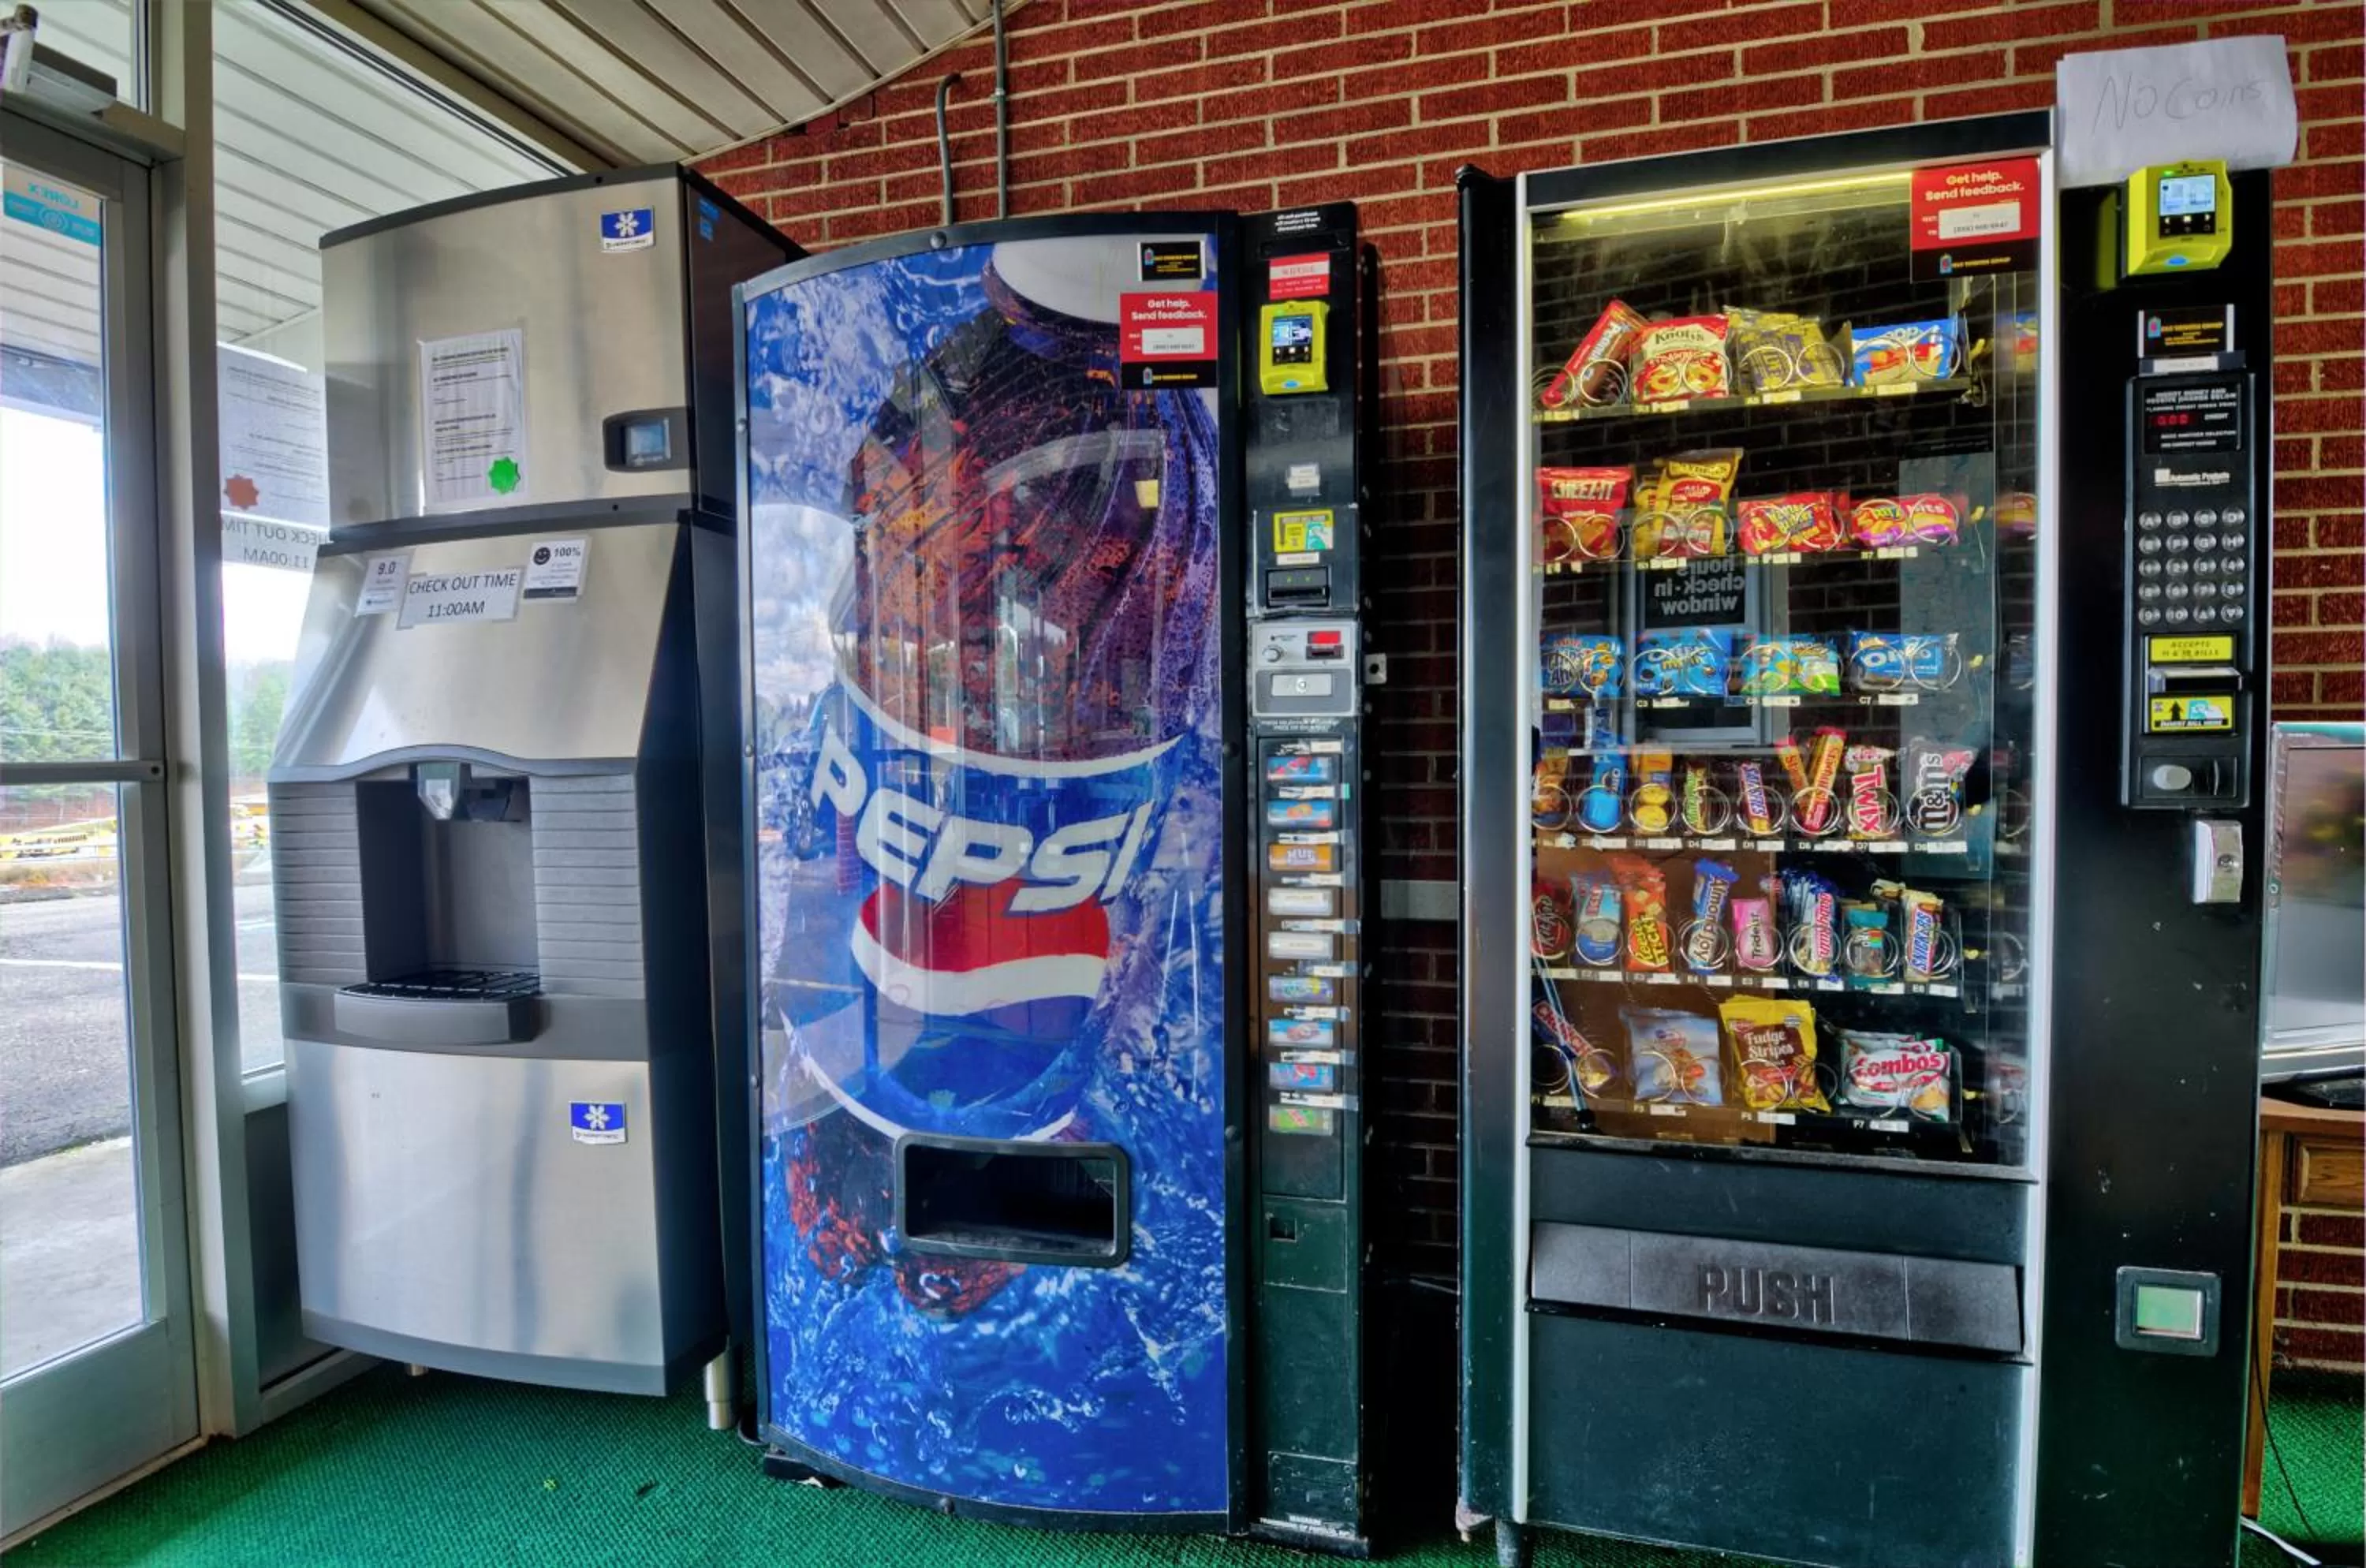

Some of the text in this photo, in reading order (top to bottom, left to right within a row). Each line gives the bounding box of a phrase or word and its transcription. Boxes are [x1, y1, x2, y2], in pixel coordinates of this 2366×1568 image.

[2092, 73, 2262, 133] No Coins
[1946, 170, 2003, 185] Get help.
[1925, 181, 2025, 201] Send feedback.
[1148, 297, 1190, 309] Get help.
[1131, 309, 1207, 321] Send feedback.
[553, 546, 580, 557] 100%
[409, 577, 447, 595] CHECK
[452, 575, 480, 592] OUT
[483, 573, 517, 588] TIME
[427, 600, 486, 618] 11:00AM
[1853, 764, 1883, 832] TWIX
[810, 720, 1155, 913] PEPSI
[1695, 873, 1730, 961] Almond Joy
[1909, 905, 1932, 973] SNICKERS
[1745, 1029, 1786, 1046] Fudge
[1748, 1043, 1795, 1059] Stripes
[1854, 1052, 1941, 1077] Combos
[1699, 1264, 1836, 1326] PUSH
